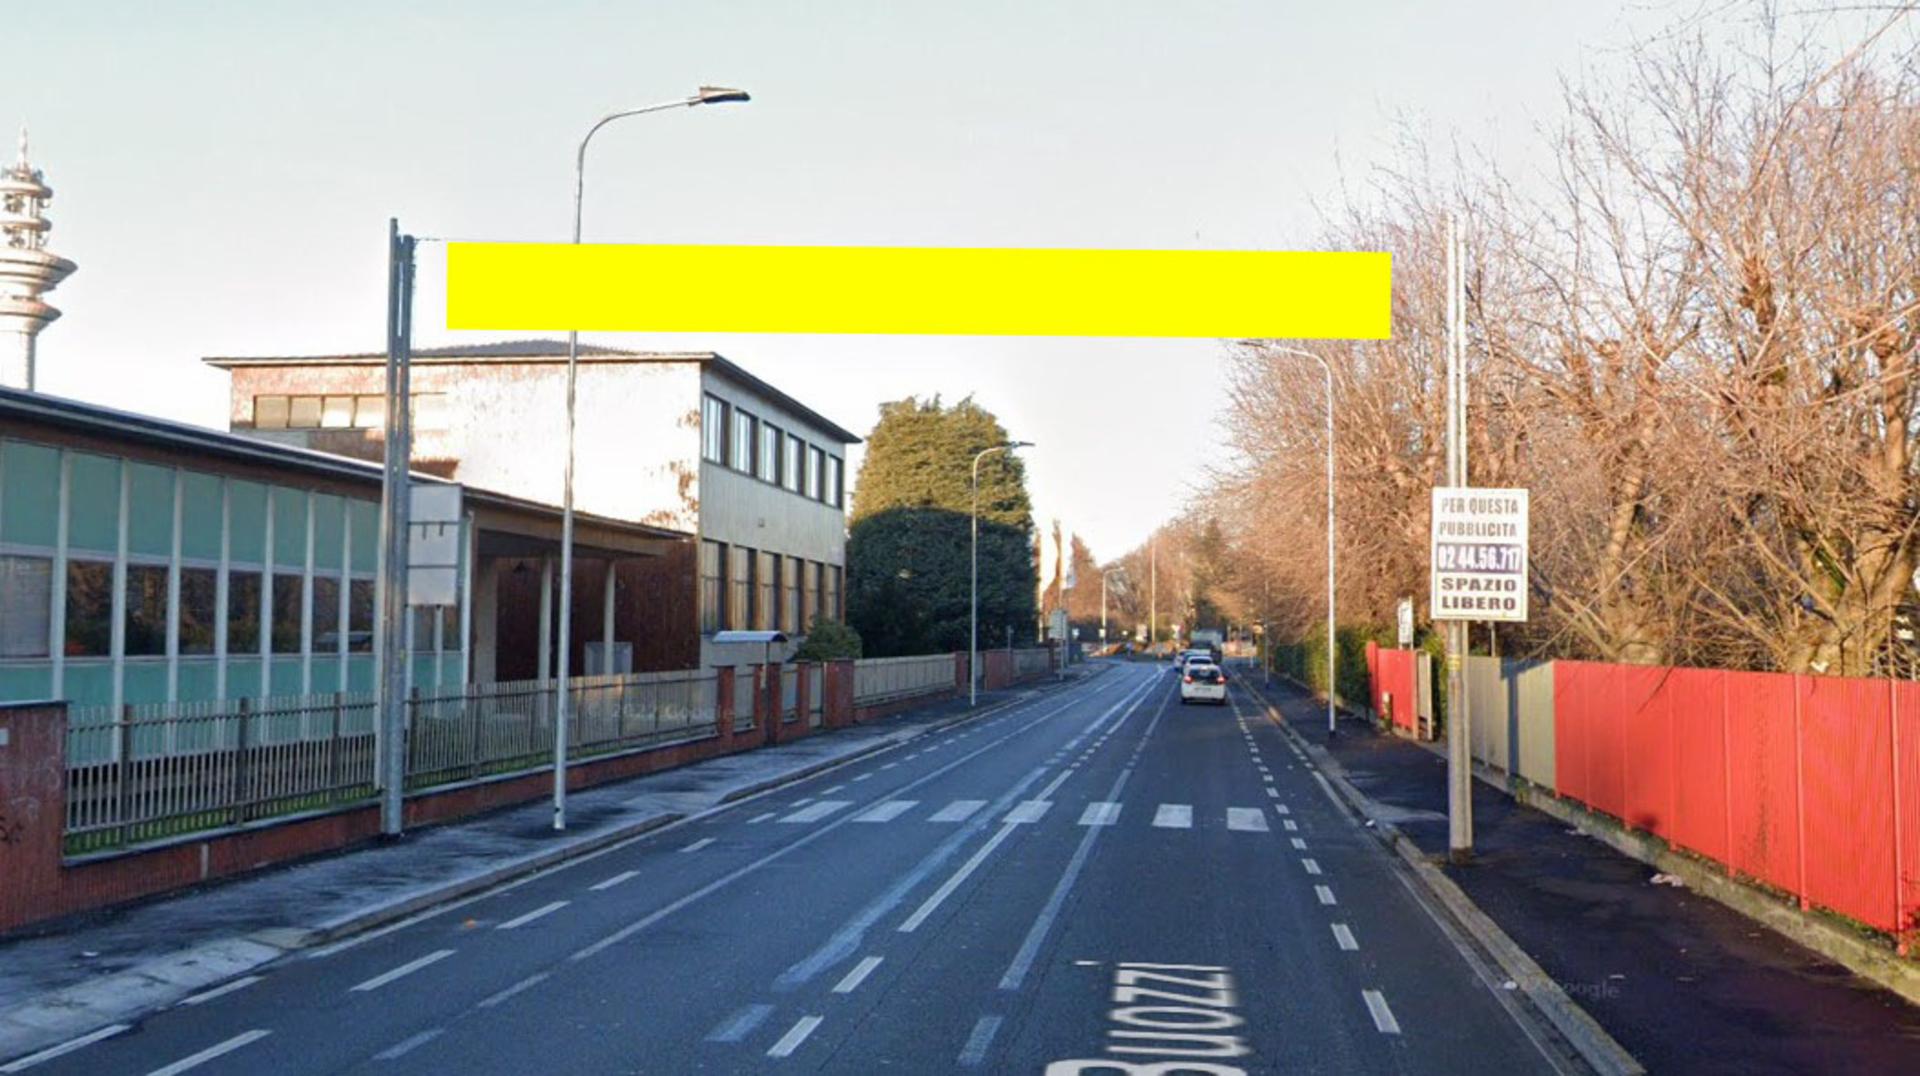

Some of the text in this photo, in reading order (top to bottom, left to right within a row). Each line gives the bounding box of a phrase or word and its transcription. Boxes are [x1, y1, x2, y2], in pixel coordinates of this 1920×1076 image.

[1441, 497, 1518, 515] PER QUESTA
[1438, 545, 1456, 569] 02
[1441, 577, 1517, 592] SPAZIO
[1441, 596, 1517, 610] LIBERO
